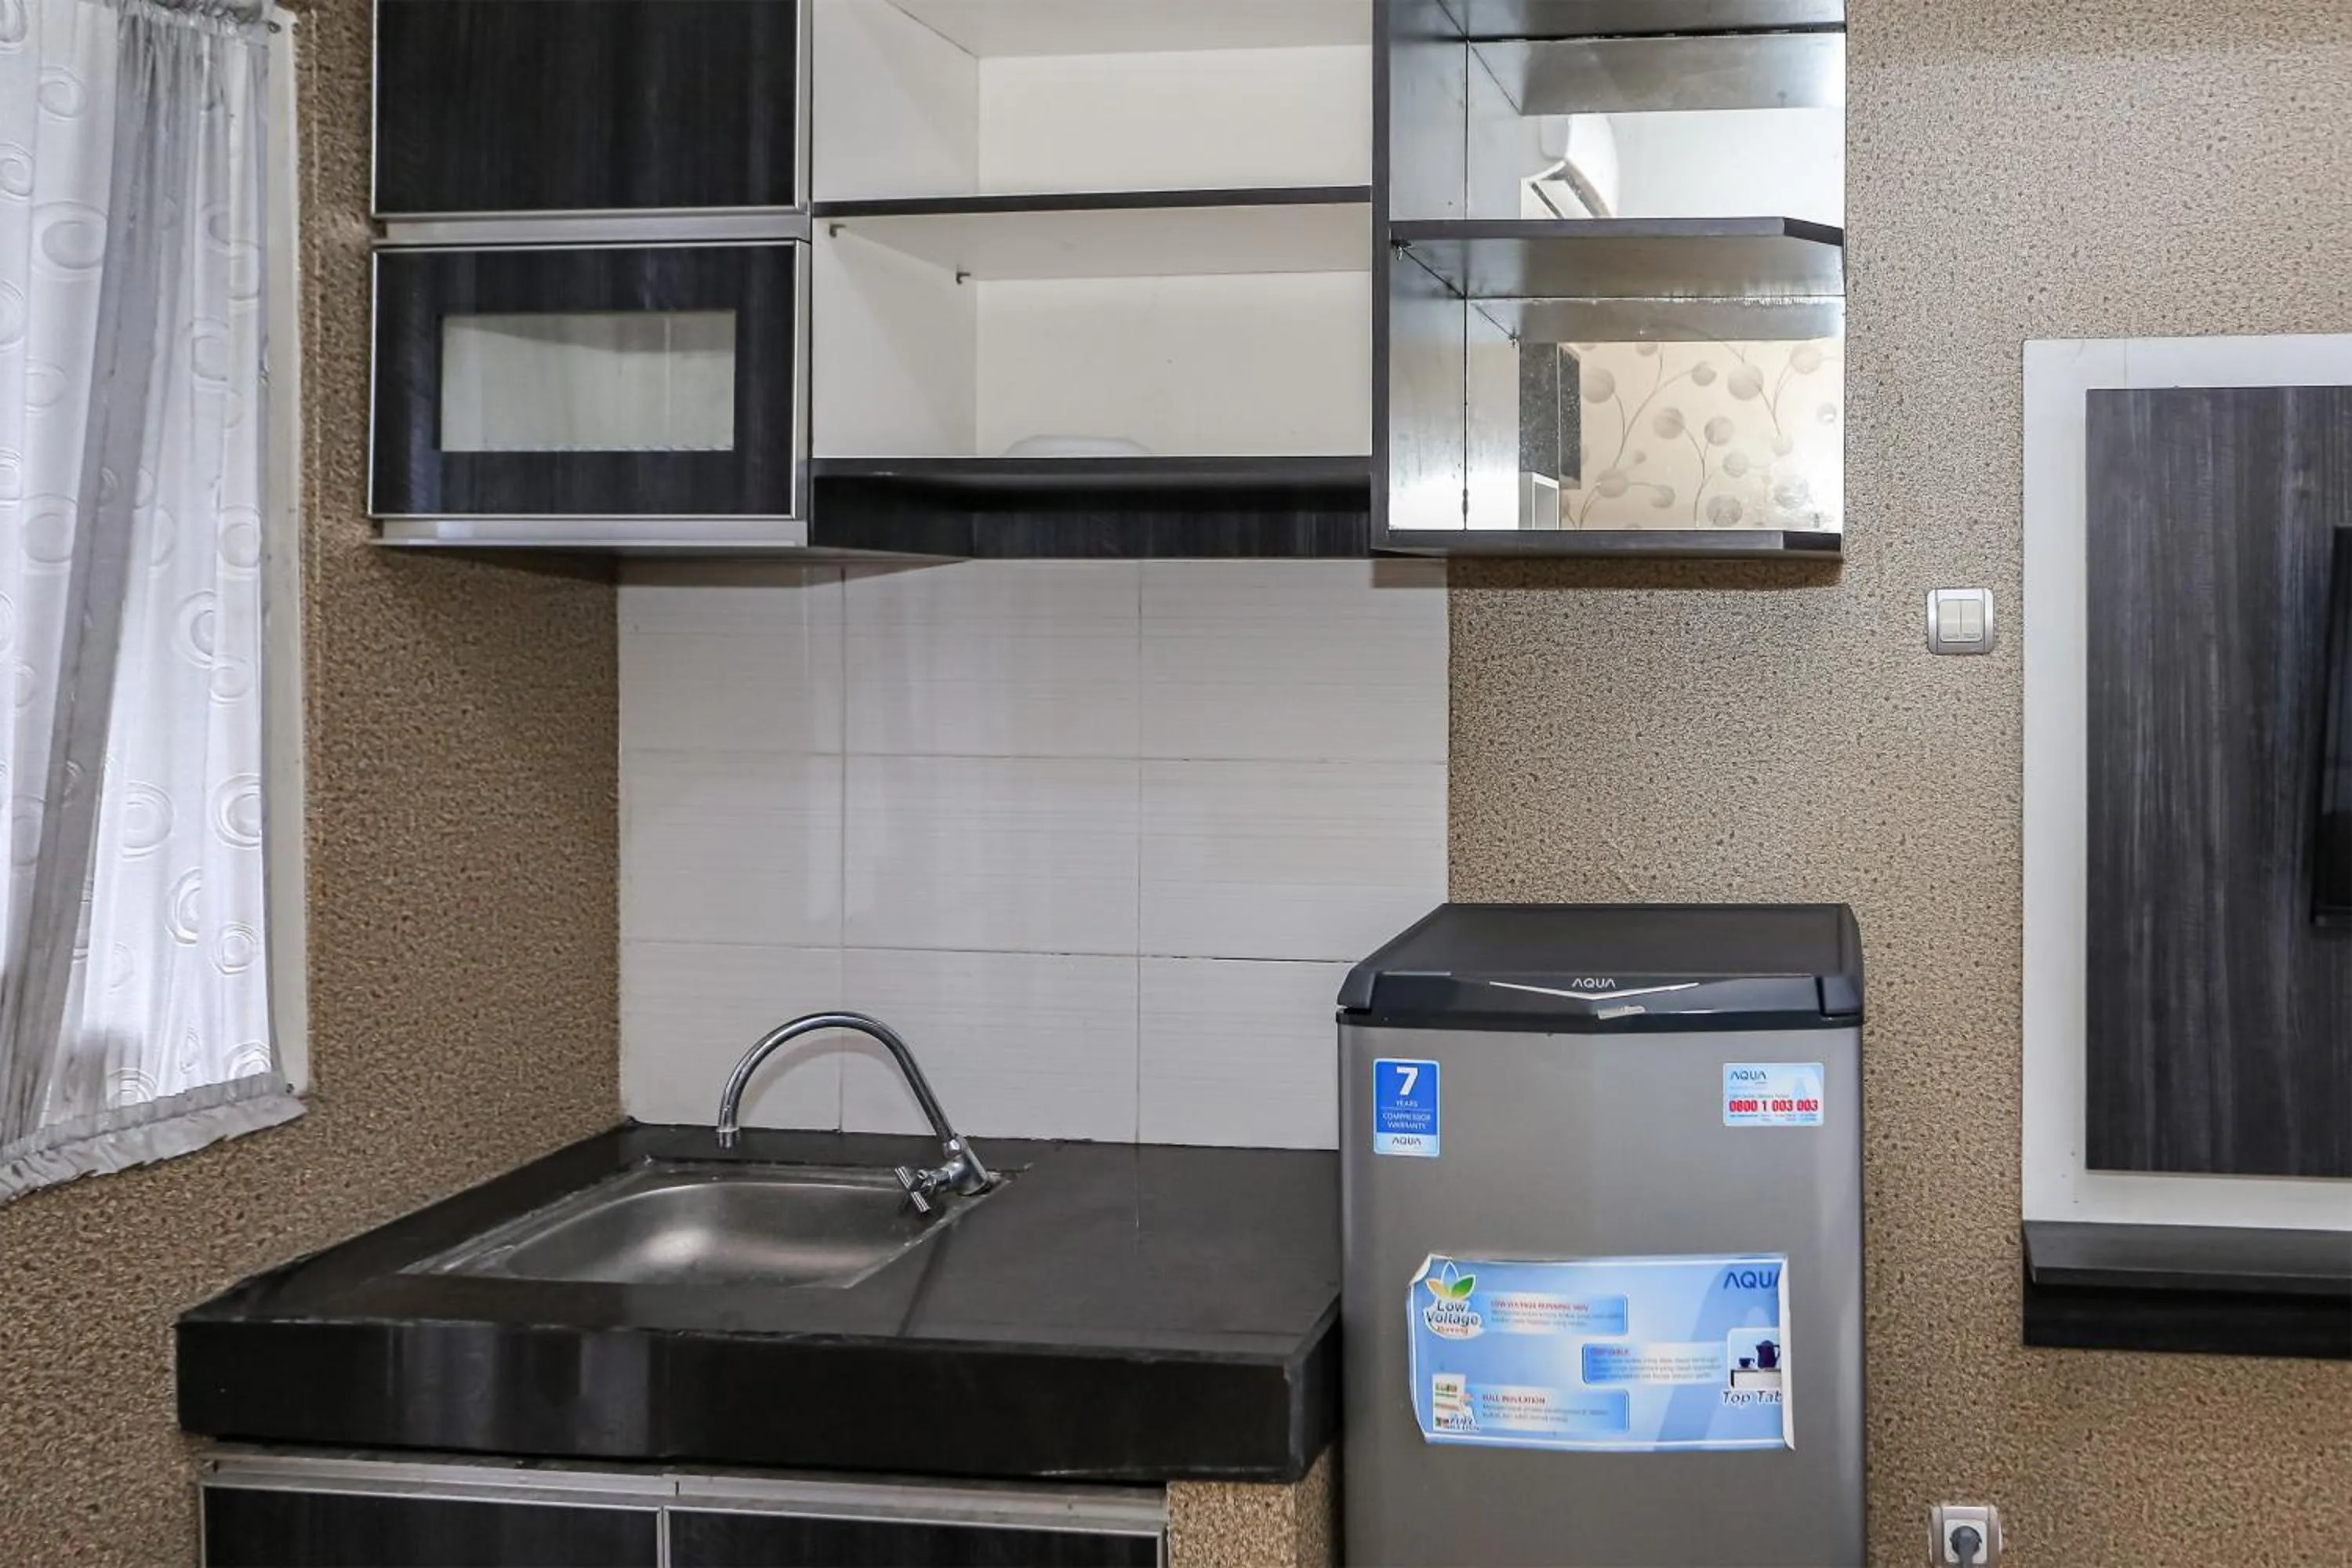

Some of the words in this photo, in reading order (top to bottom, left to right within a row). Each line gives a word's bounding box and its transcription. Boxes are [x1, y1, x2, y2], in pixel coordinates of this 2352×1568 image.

[1571, 978, 1617, 989] AQUA
[1396, 1066, 1418, 1095] 7
[1730, 1070, 1766, 1080] AQUA
[1730, 1100, 1759, 1112] 0800
[1762, 1100, 1767, 1112] 1
[1772, 1099, 1793, 1112] 003
[1796, 1099, 1819, 1112] 003
[1392, 1137, 1421, 1145] AQUA
[1436, 1300, 1466, 1312] Low
[1426, 1310, 1479, 1327] Voltage
[1723, 1391, 1751, 1406] Top
